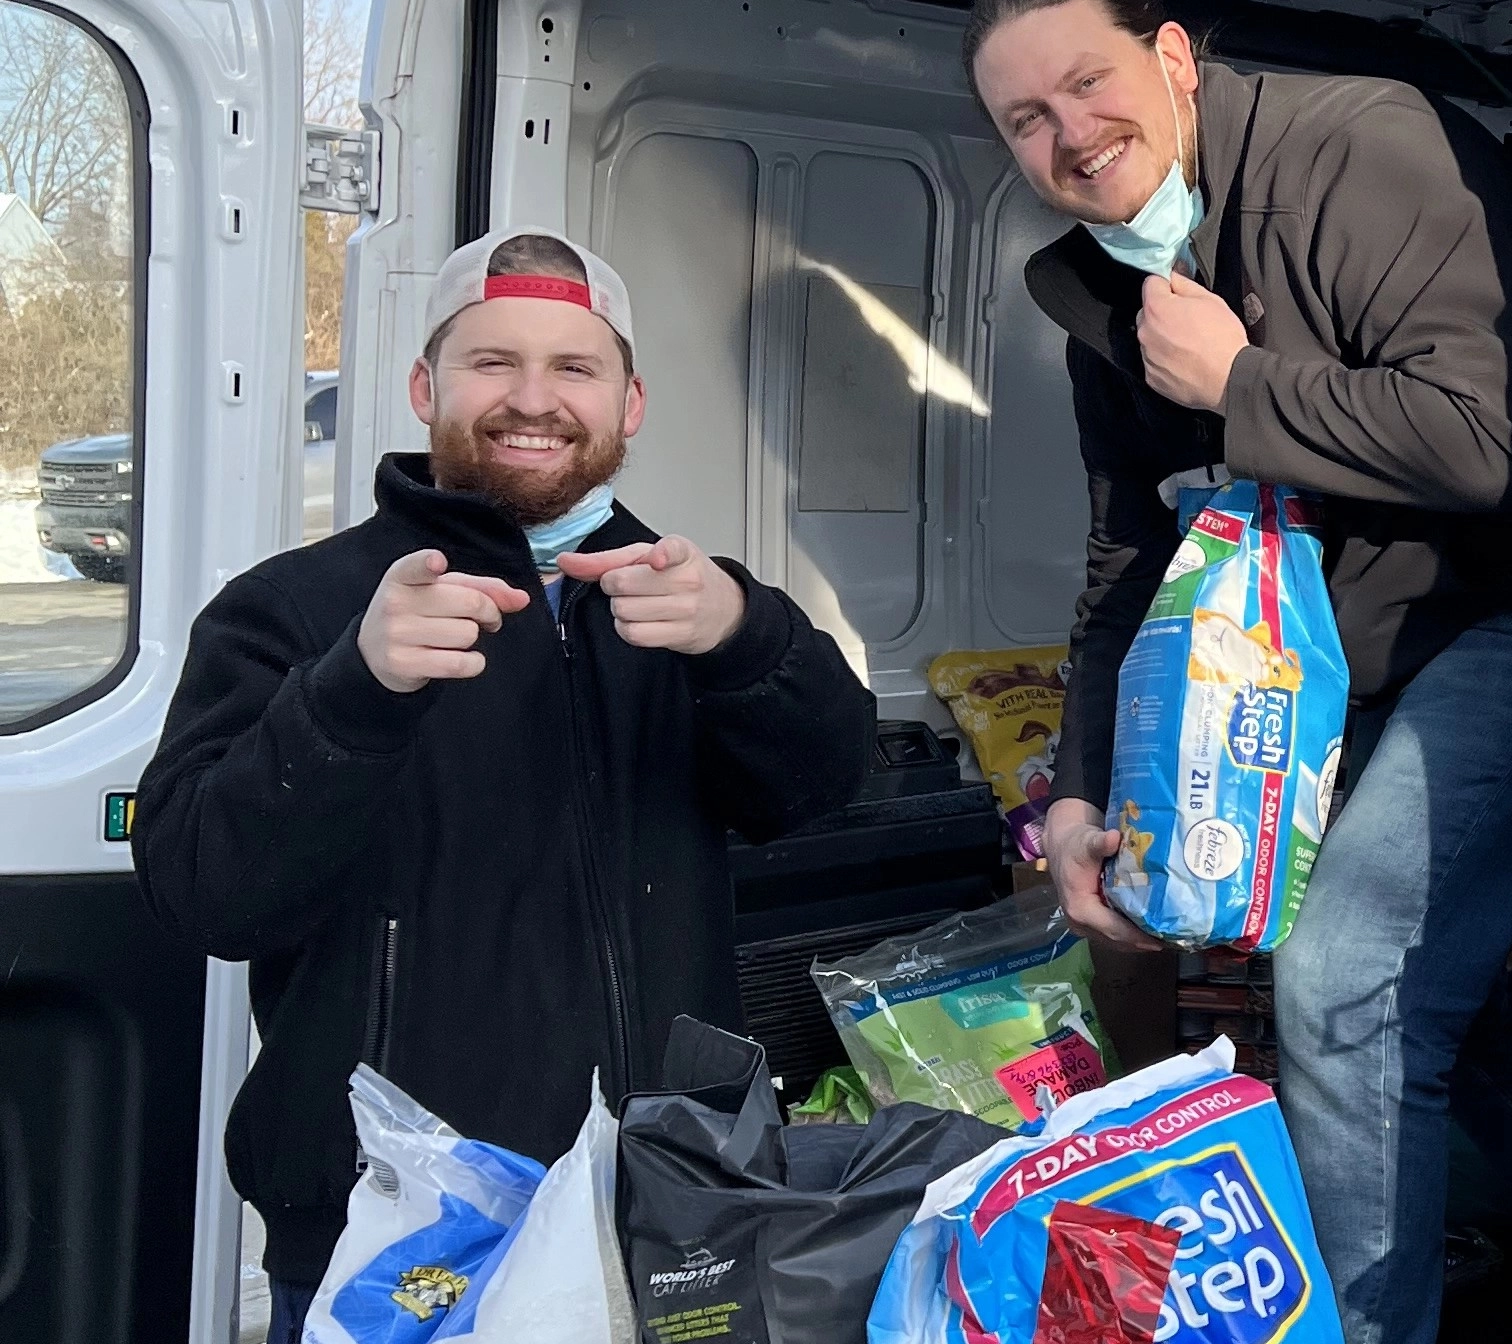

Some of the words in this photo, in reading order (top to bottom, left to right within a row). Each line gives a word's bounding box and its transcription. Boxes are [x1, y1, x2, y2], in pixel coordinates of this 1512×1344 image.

[996, 694, 1024, 709] WITH
[1024, 688, 1048, 702] REAL
[1233, 686, 1266, 757] Step
[1261, 690, 1288, 764] Fresh
[1189, 793, 1203, 810] LB
[1190, 769, 1211, 790] 21
[1263, 786, 1278, 836] 7-DAY
[1203, 824, 1228, 877] febreze
[1257, 838, 1271, 877] ODOR
[1007, 1135, 1099, 1198] 7-DAY
[1106, 1125, 1158, 1149] ODOR
[1155, 1089, 1242, 1134] CONTROL
[1153, 1169, 1264, 1260] esh
[649, 1264, 708, 1286] WORLD'S
[708, 1259, 736, 1276] BEST
[653, 1282, 677, 1299] CAT
